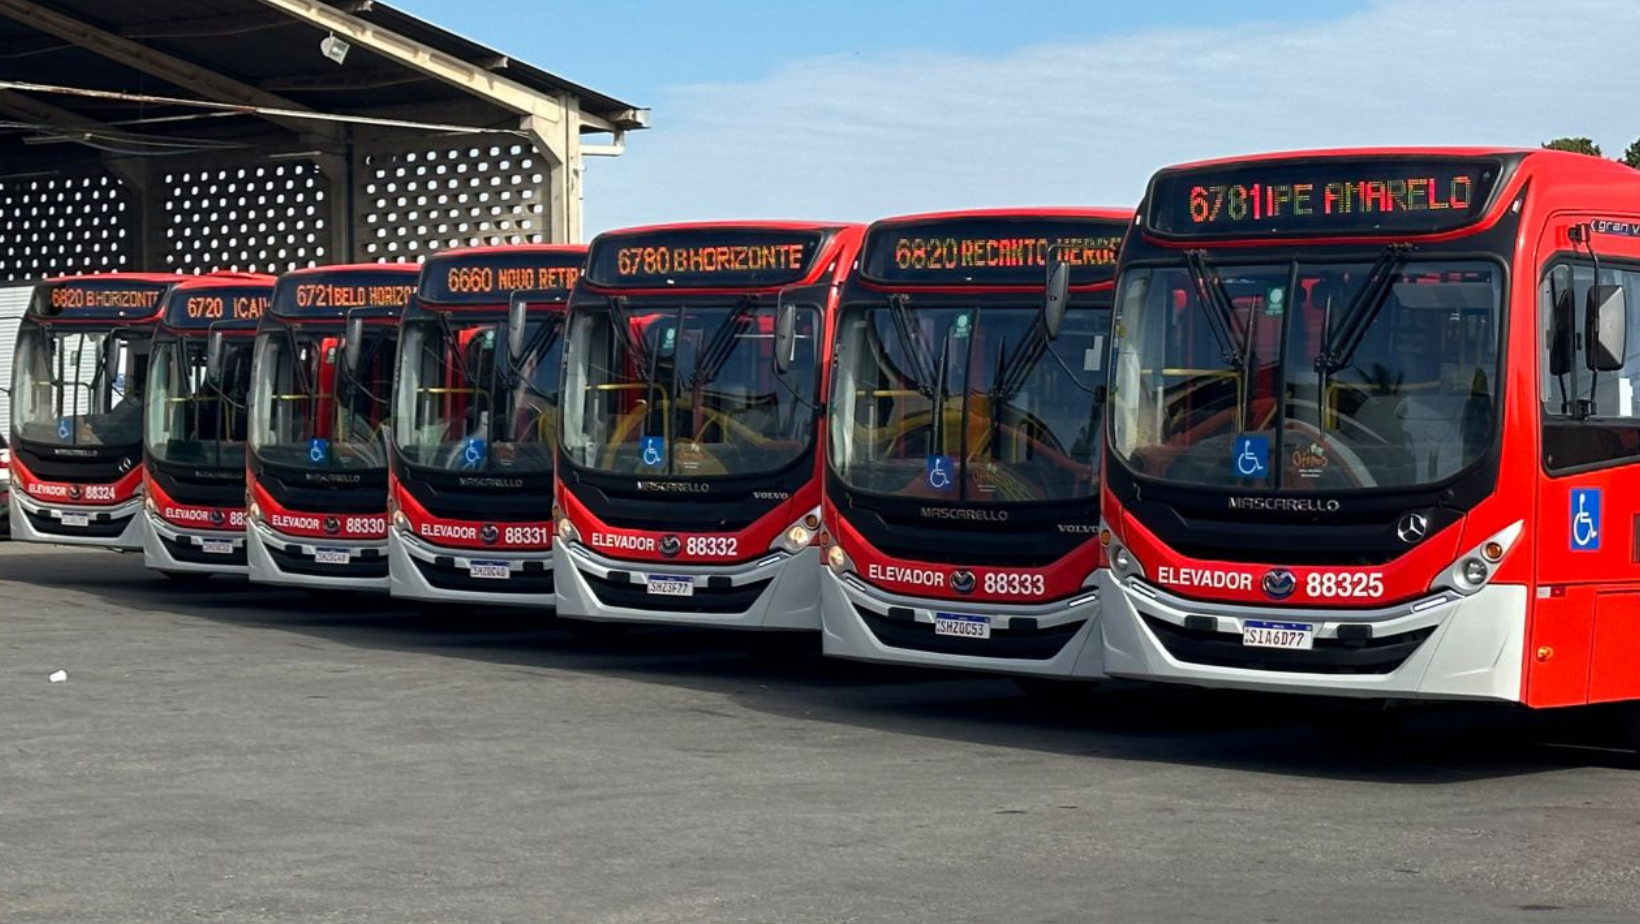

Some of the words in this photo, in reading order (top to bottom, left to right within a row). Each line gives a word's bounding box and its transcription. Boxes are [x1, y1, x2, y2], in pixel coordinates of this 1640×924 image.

[1190, 184, 1261, 222] 6781
[1266, 183, 1313, 217] IPE
[1324, 176, 1471, 214] AMARELO
[1599, 220, 1629, 233] gran
[618, 247, 670, 275] 6780
[895, 238, 957, 268] 6820
[961, 238, 1047, 266] RECANTO
[448, 268, 492, 292] 6660
[53, 289, 84, 308] 6820
[297, 285, 333, 306] 6721
[333, 286, 366, 306] BELO
[187, 298, 223, 318] 6720
[28, 483, 67, 497] ELEVADOR
[85, 486, 116, 499] 88324
[753, 491, 789, 499] VOLVO
[165, 508, 208, 521] ELEVADOR
[921, 507, 1008, 521] MASCARELLO
[1228, 497, 1341, 512] MASCARELLO
[272, 515, 320, 529] ELEVADOR
[346, 518, 385, 533] 88330
[421, 524, 476, 539] ELEVADOR
[505, 527, 547, 544] 88331
[592, 533, 654, 551] ELEVADOR
[686, 536, 737, 556] 88332
[869, 564, 944, 587] ELEVADOR
[984, 572, 1045, 595] 88333
[1158, 566, 1252, 590] ELEVADOR
[1306, 572, 1383, 598] 88325
[1249, 629, 1304, 646] SIA6D77
